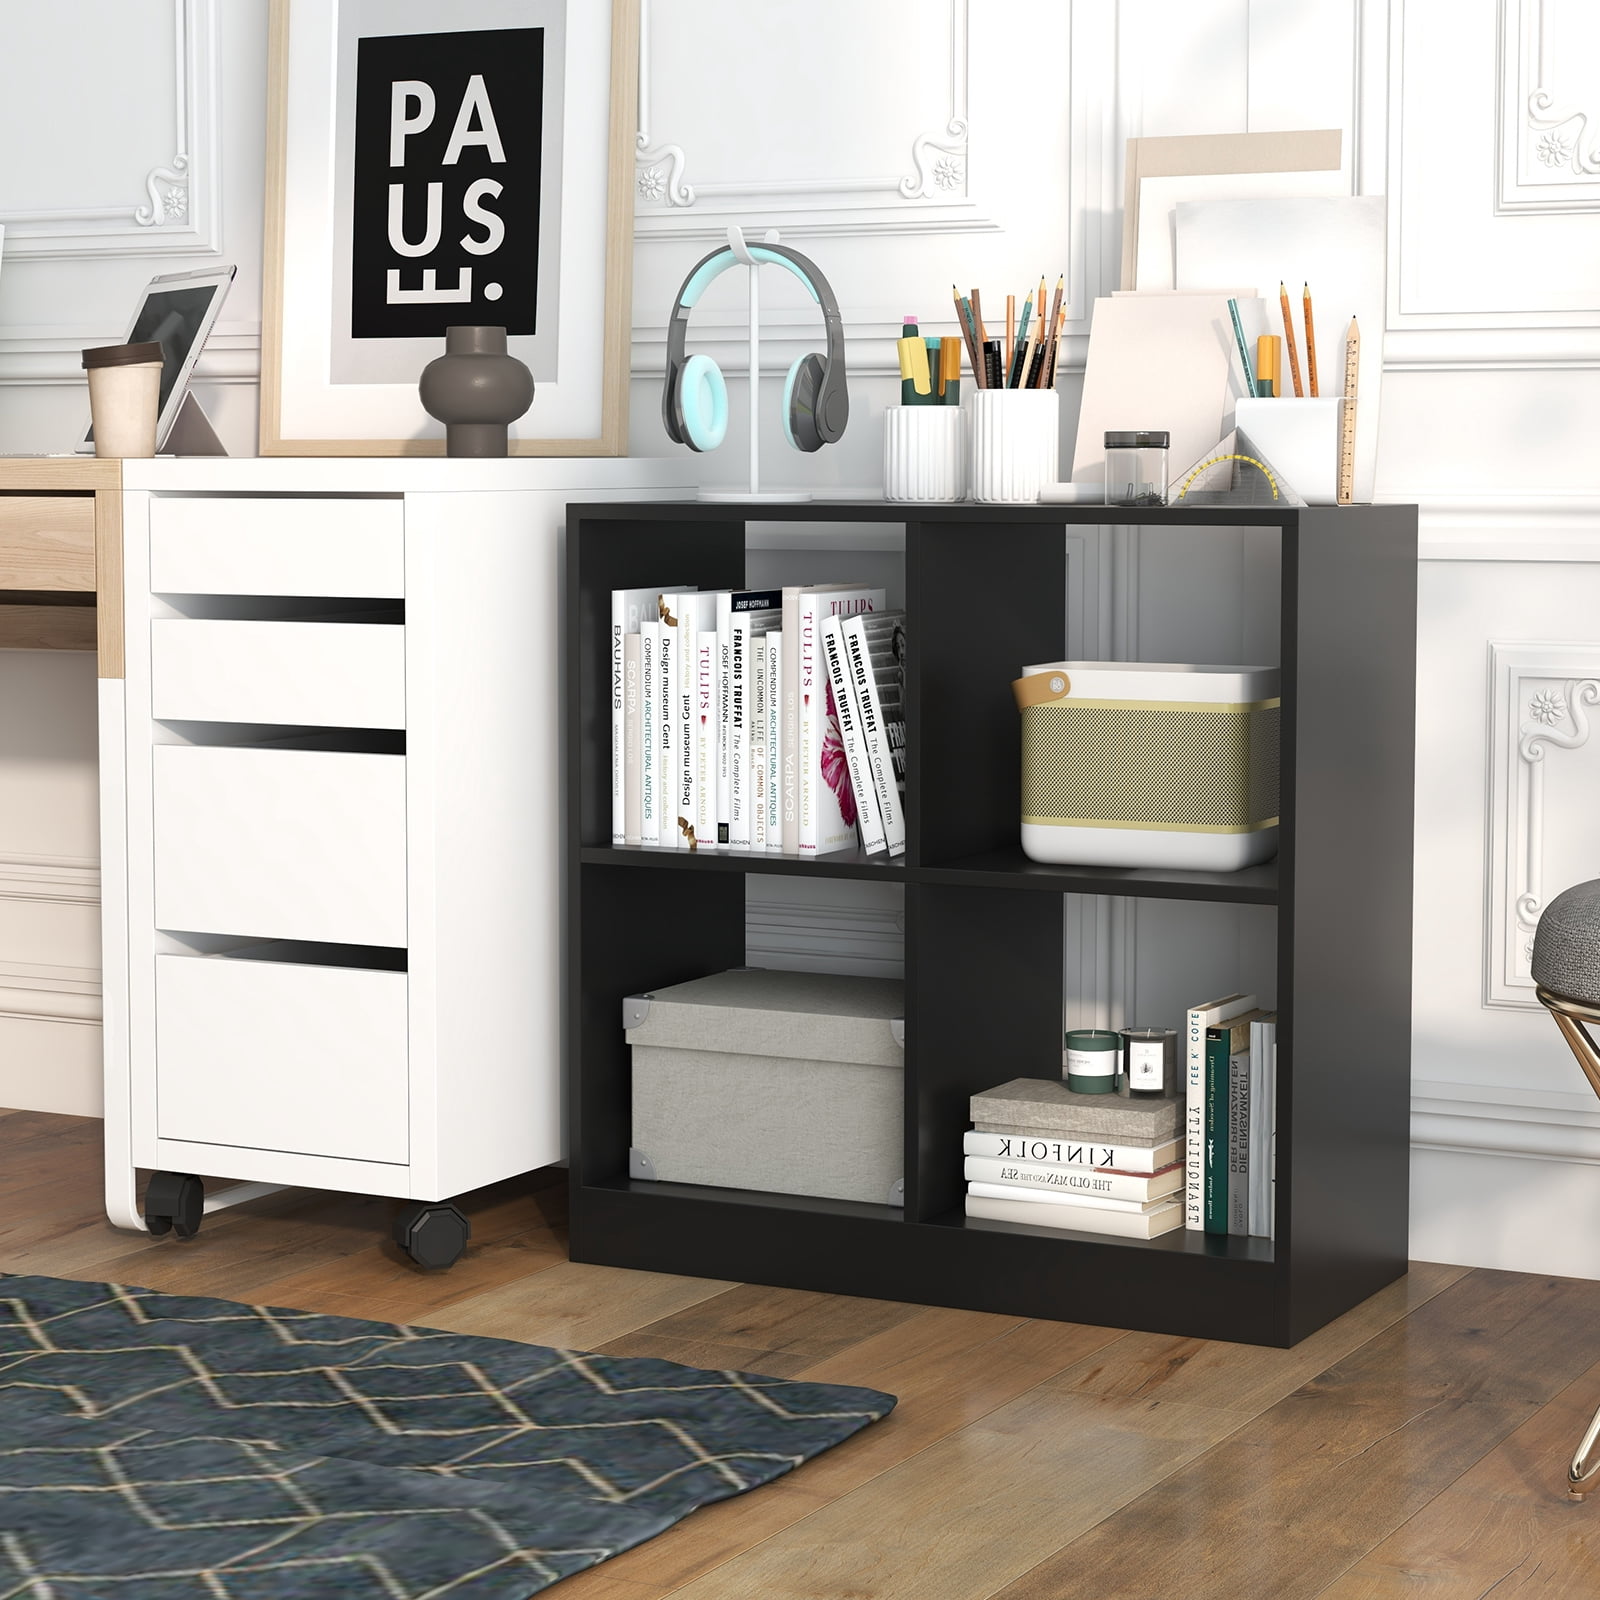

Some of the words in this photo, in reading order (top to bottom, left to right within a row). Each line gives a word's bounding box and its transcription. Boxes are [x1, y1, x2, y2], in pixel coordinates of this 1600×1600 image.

[389, 74, 507, 167] PA
[387, 178, 505, 258] US
[735, 600, 748, 609] JOSEF
[644, 637, 652, 698] COMPENDIUM
[661, 639, 670, 674] Design
[733, 629, 742, 680] FRANCOIS
[803, 612, 813, 687] TULIPS
[825, 633, 843, 685] FRANCOIS
[627, 660, 635, 714] SCARPA
[700, 646, 710, 709] TULIPS
[769, 647, 777, 707] COMPENDIUM
[682, 694, 690, 720] Gent
[734, 684, 742, 729] TRUFFAT
[803, 721, 808, 734] BY
[837, 687, 854, 733] TRUFFAT
[848, 634, 867, 685] FRANCOIS
[860, 688, 877, 733] TRUFFAT
[870, 738, 878, 754] The
[874, 757, 888, 798] Complete
[883, 802, 893, 825] Films
[644, 700, 652, 772] ARCHITECTURAL
[662, 724, 670, 749] Gent
[757, 747, 764, 758] OF
[769, 709, 777, 779] ARCHITECTURAL
[847, 737, 855, 753] The
[682, 770, 692, 806] Design
[732, 752, 741, 795] Complete
[785, 754, 794, 822] SCARPA
[850, 756, 864, 797] Complete
[644, 774, 652, 820] ANTIQUES
[860, 801, 870, 824] Films
